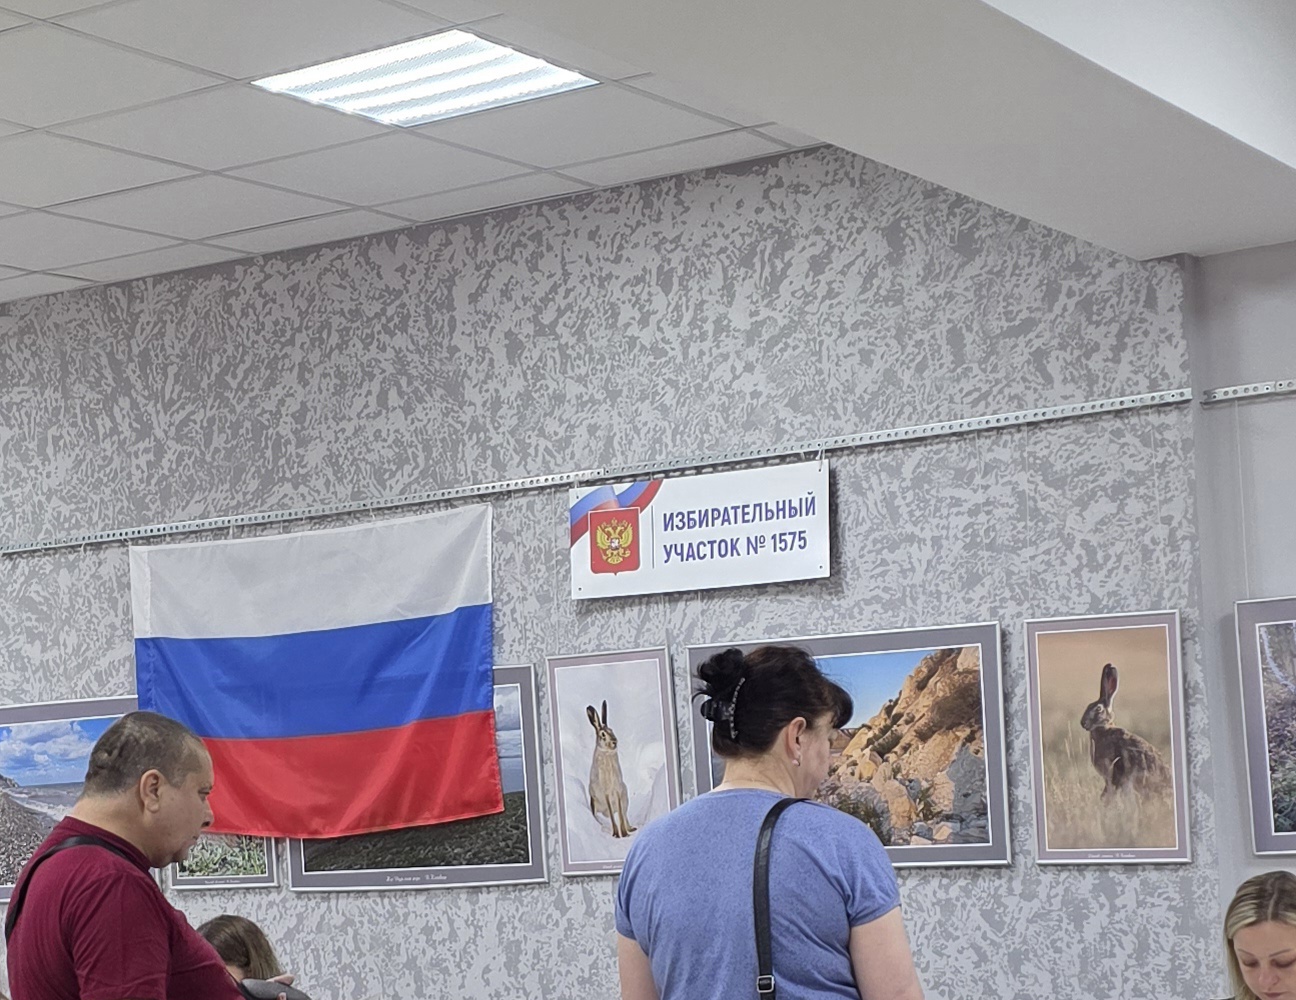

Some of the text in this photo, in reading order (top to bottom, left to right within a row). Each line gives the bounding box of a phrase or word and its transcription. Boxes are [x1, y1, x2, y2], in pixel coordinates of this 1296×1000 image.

[662, 491, 817, 533] ИЗБИРАТЕЛЬНЫЙ
[662, 530, 808, 564] УЧАСТОК № 1575
